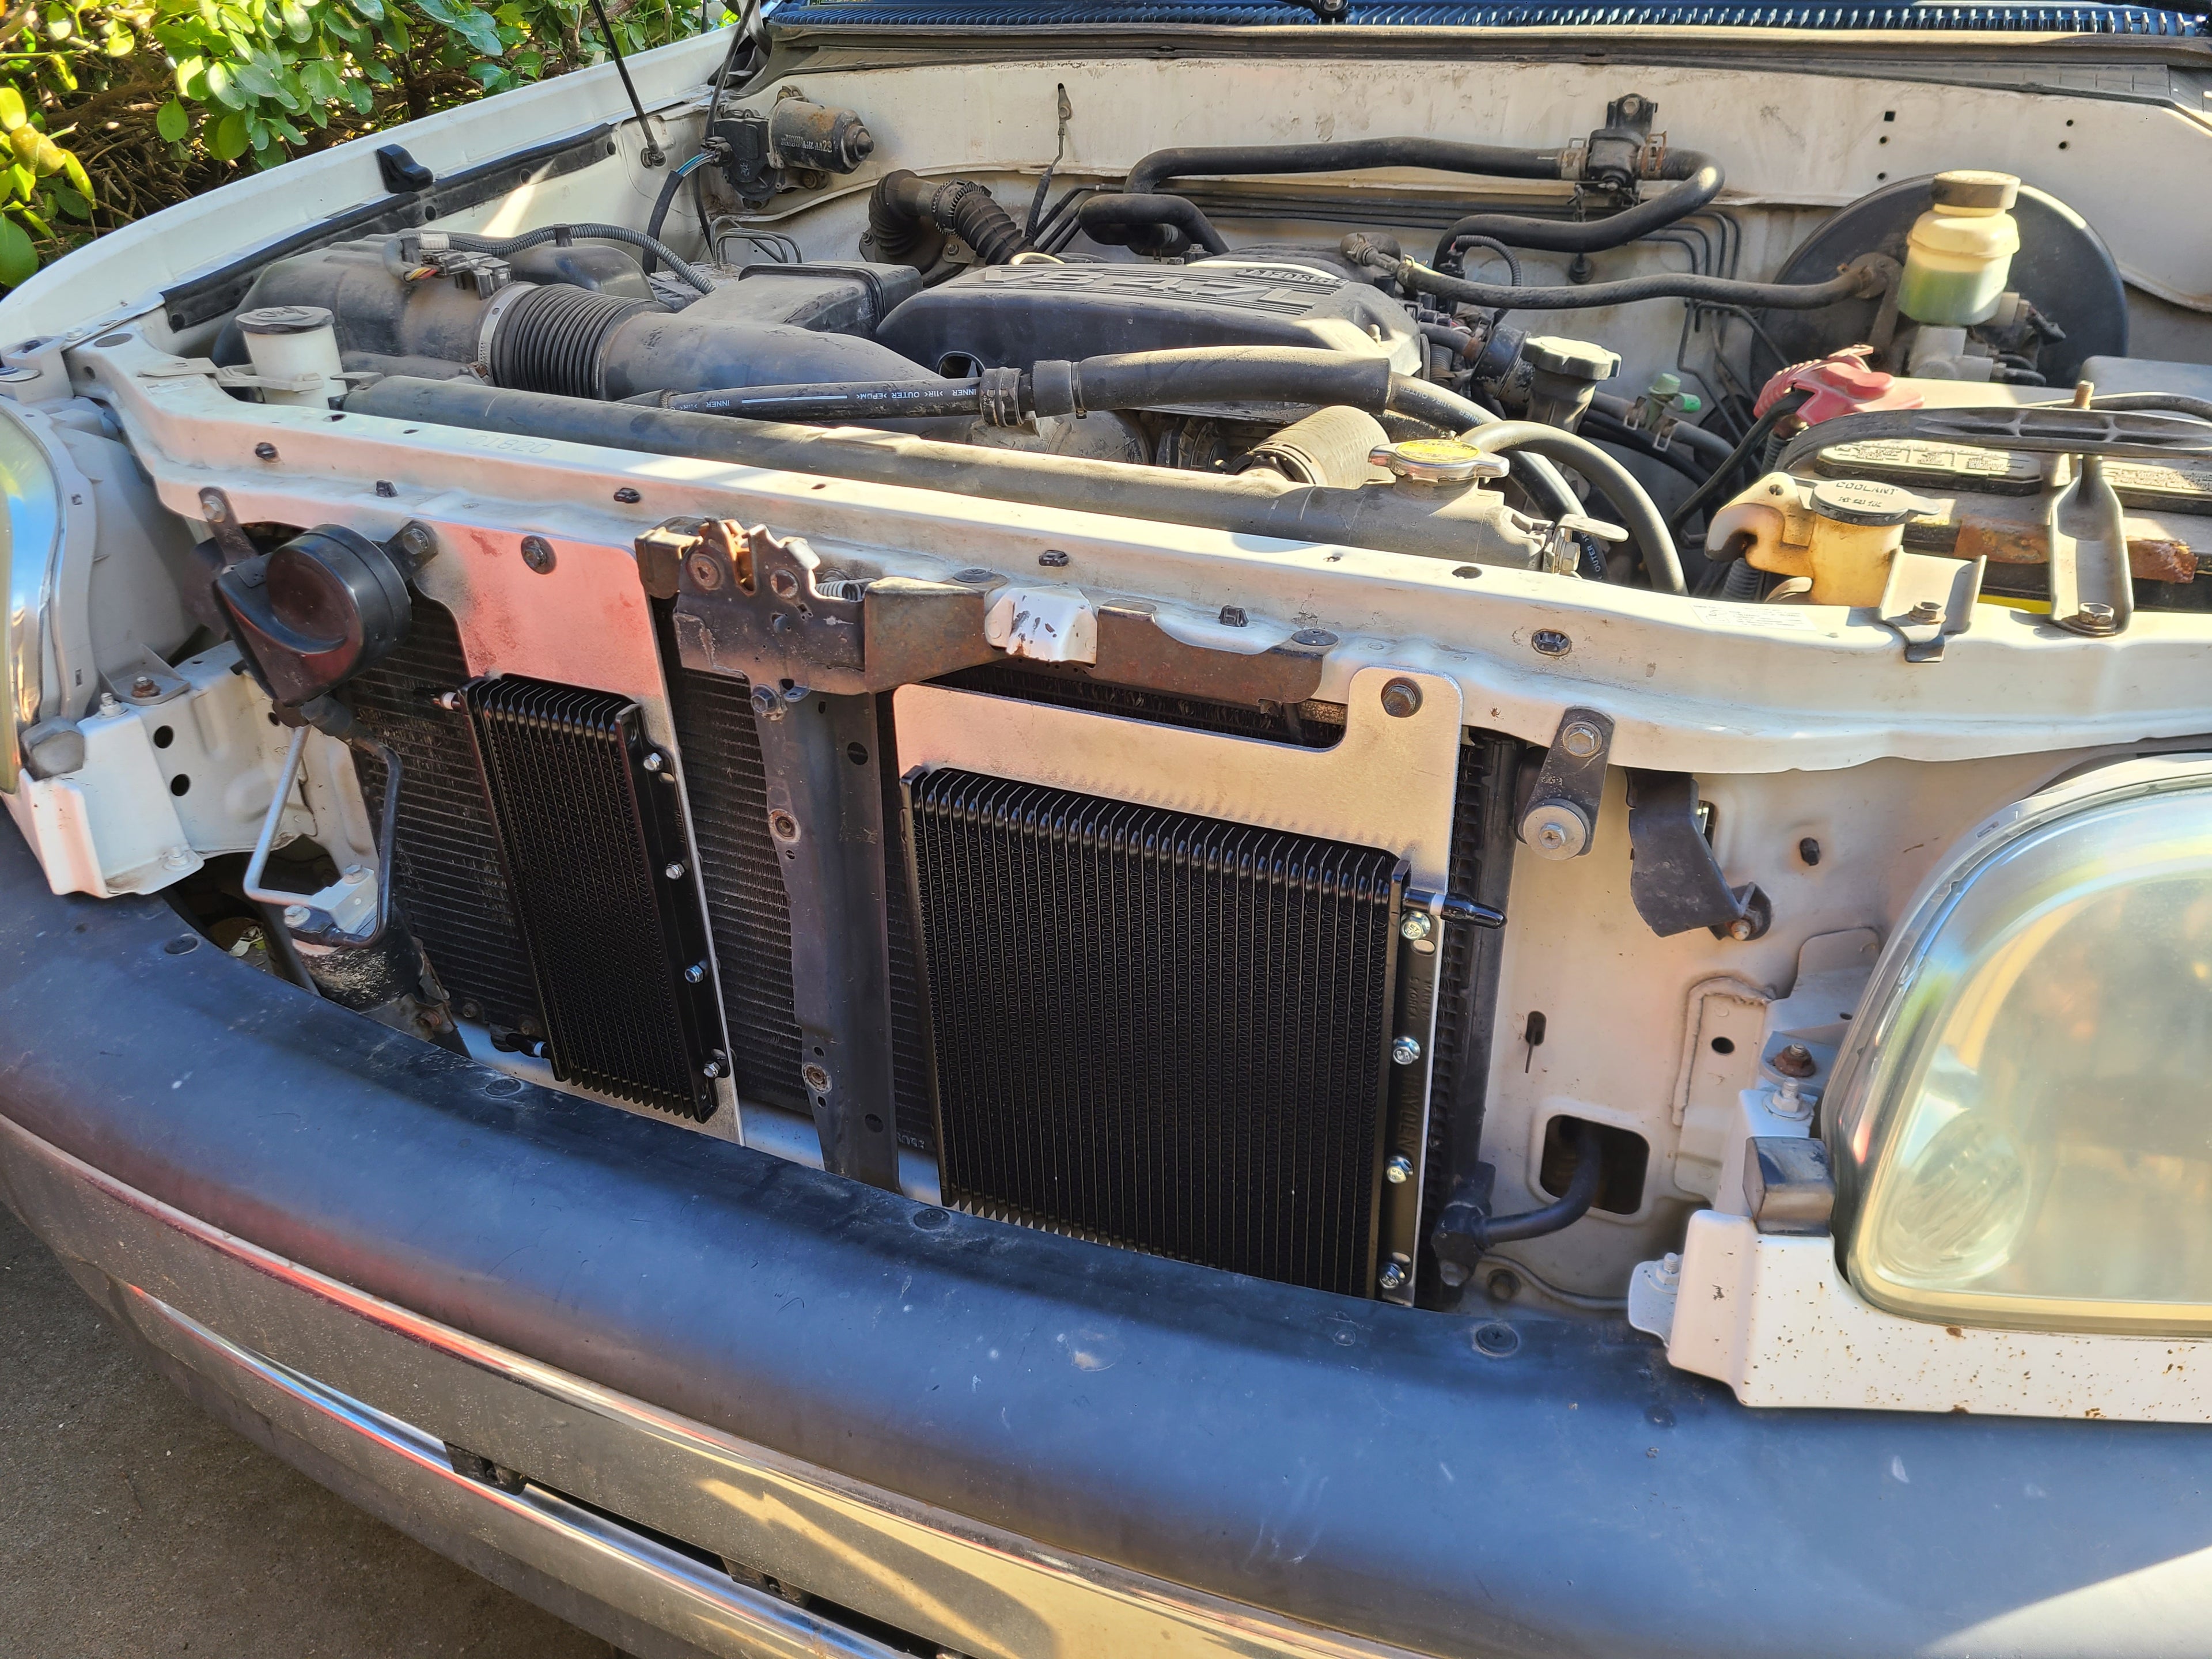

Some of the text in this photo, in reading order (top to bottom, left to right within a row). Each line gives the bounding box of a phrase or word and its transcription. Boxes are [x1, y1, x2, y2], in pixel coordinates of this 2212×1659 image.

[985, 268, 1316, 309] V8 4.7L
[952, 389, 977, 397] INNER
[1400, 384, 1429, 400] OUTER
[706, 399, 730, 408] INNER
[1459, 408, 1483, 425] INNER
[1836, 482, 1899, 495] COOLANT
[1586, 544, 1601, 573] OUTER
[1400, 1074, 1422, 1152] HAYDEN
